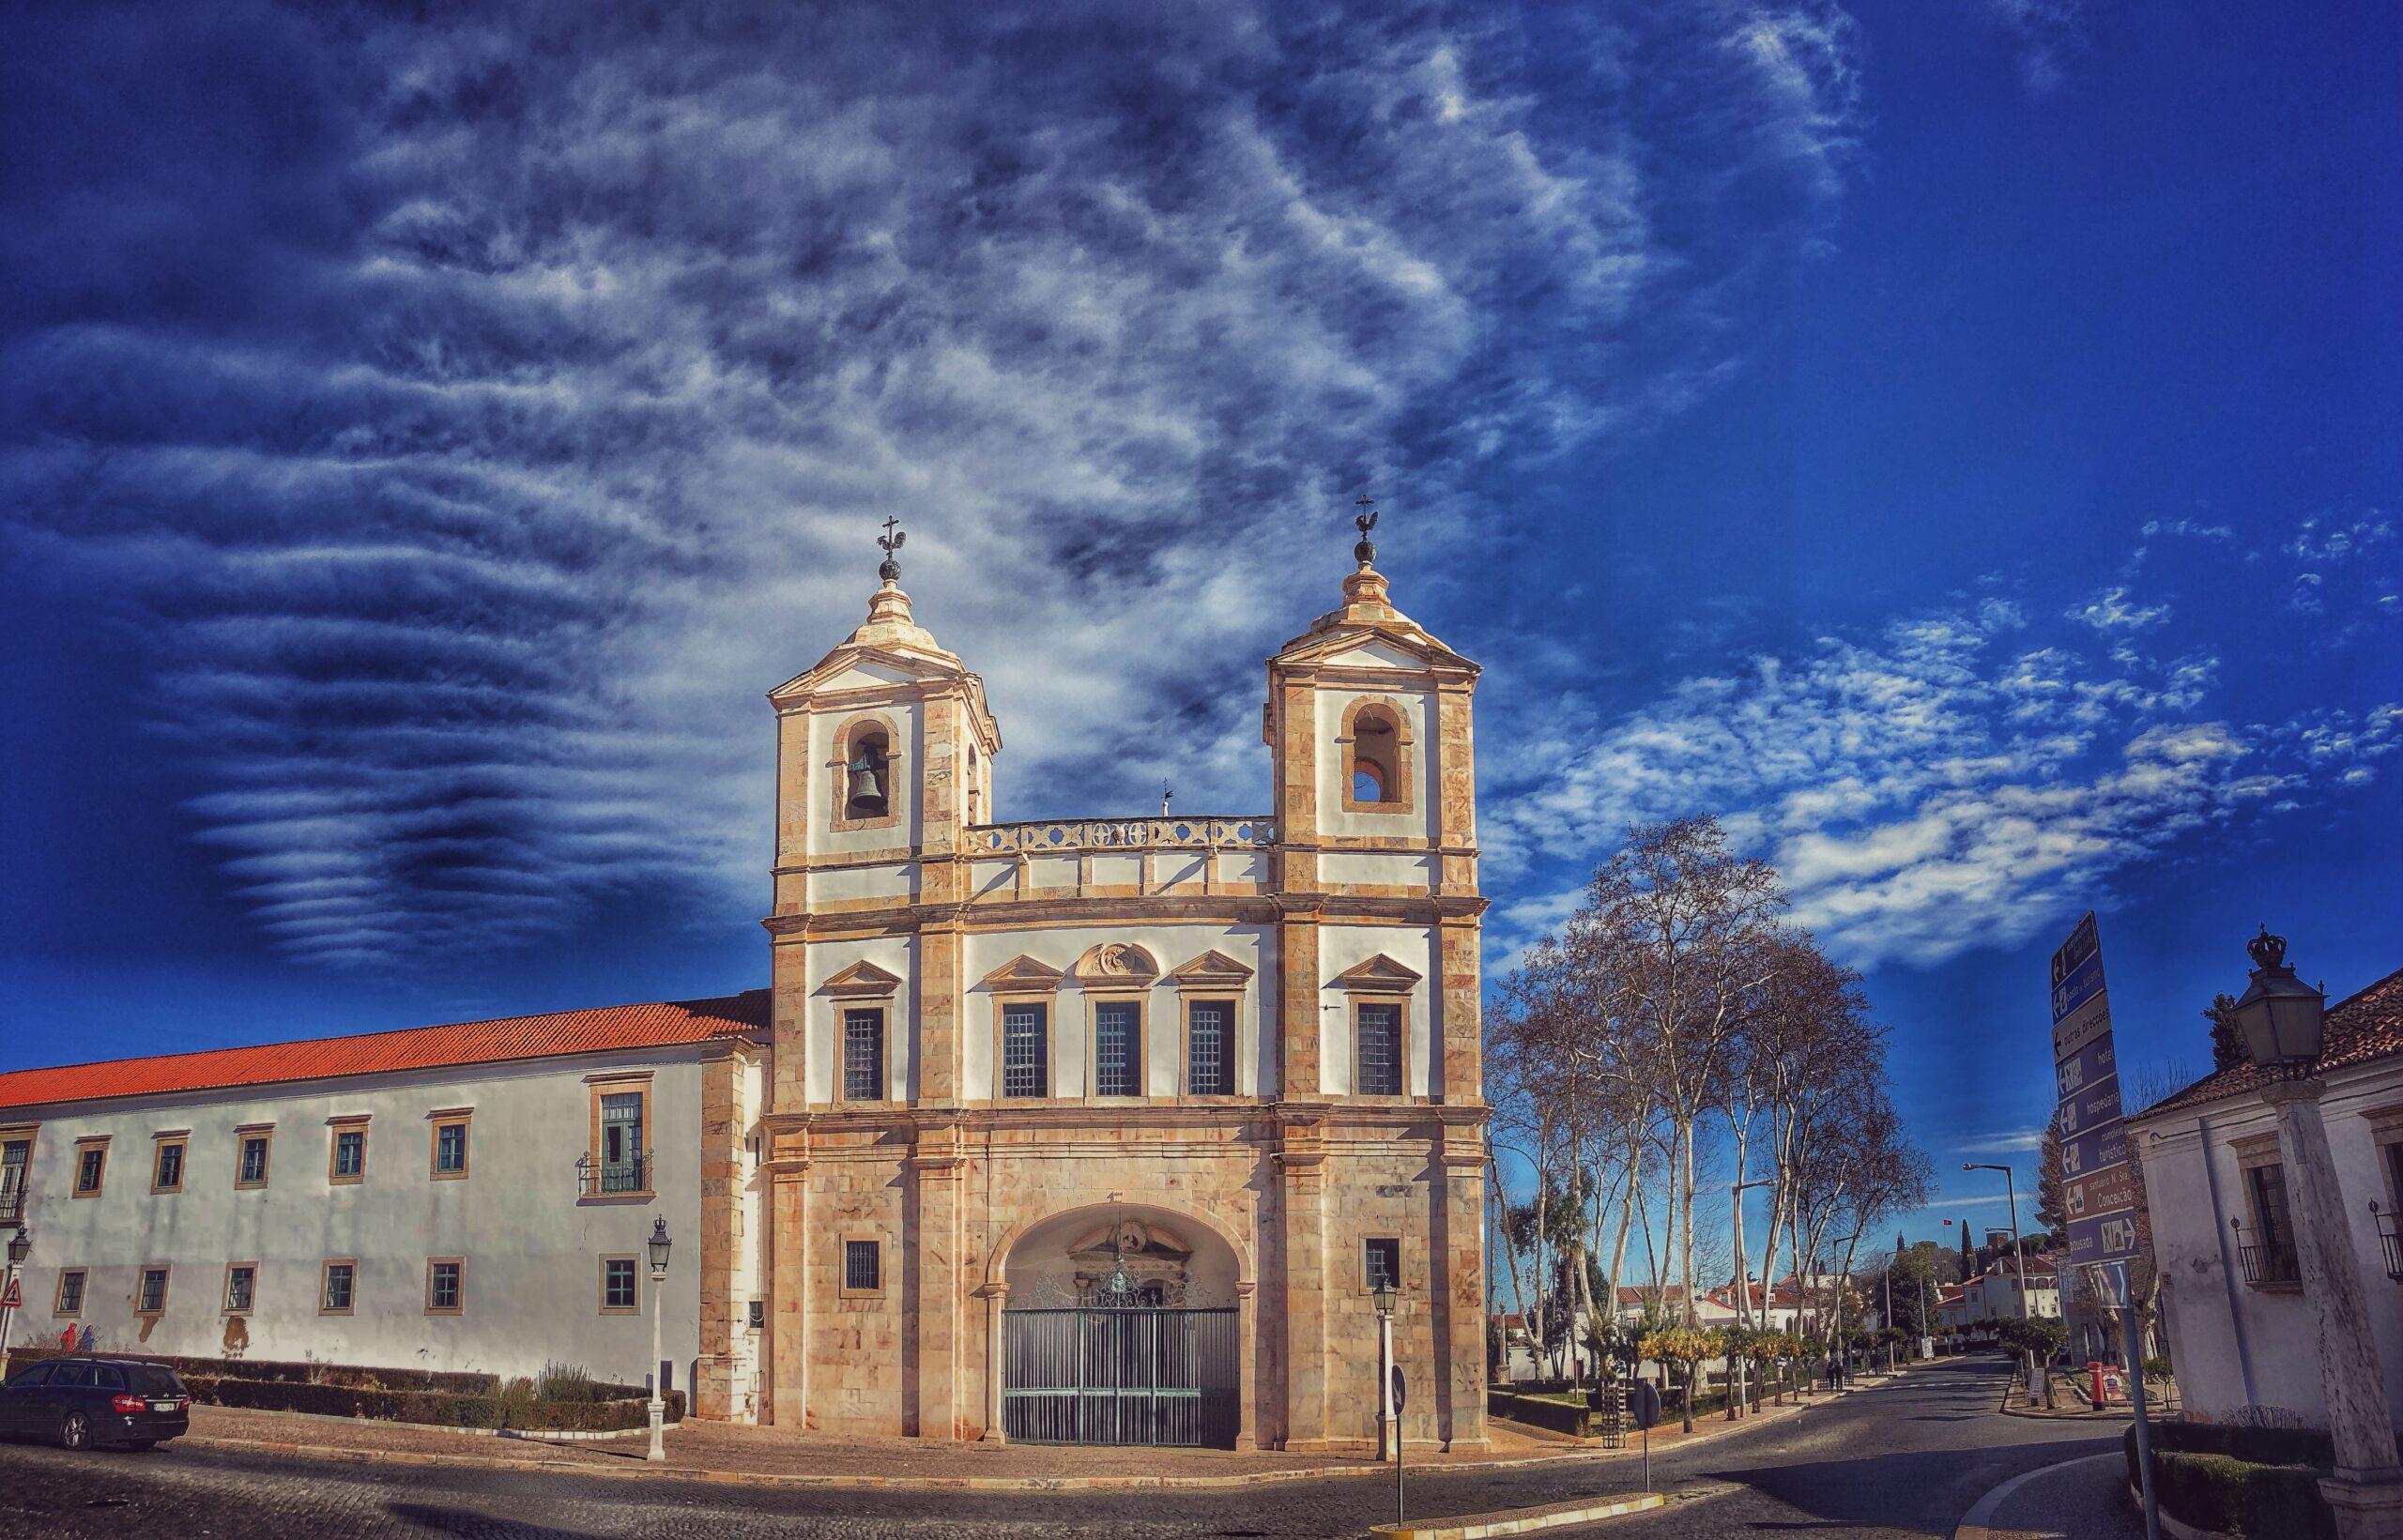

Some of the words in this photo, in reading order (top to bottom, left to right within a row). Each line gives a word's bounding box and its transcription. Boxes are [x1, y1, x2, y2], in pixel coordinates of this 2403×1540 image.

[2064, 1028, 2081, 1046] outras
[2082, 1007, 2109, 1033] direcções
[2097, 1045, 2115, 1066] hotel
[2086, 1090, 2120, 1116] hospedaria
[2097, 1186, 2132, 1209] Conceição
[2070, 1233, 2093, 1252] pousada
